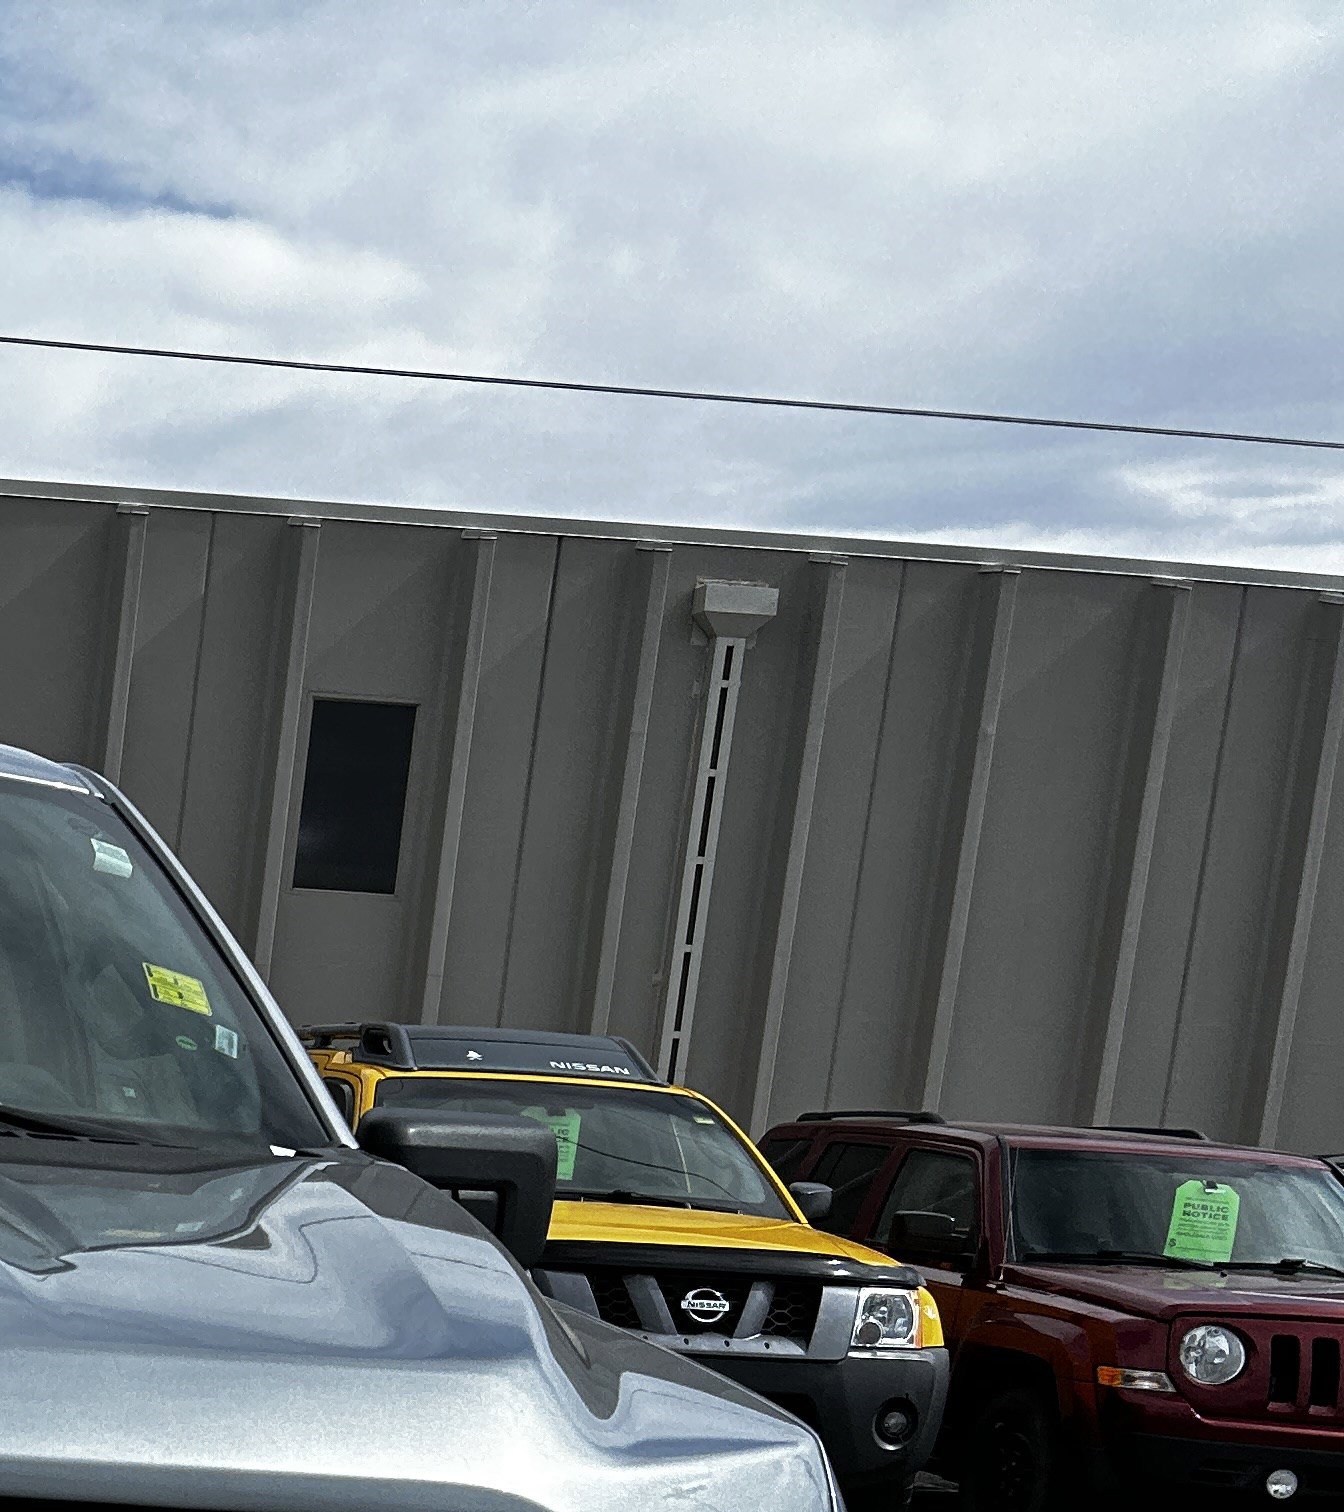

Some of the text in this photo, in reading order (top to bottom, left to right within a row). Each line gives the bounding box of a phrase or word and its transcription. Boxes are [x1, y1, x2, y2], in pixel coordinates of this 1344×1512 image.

[549, 1060, 631, 1076] NISSAN
[1183, 1202, 1230, 1214] PUBLIC
[1181, 1209, 1230, 1222] NOTICE
[686, 1300, 727, 1310] NISSAN
